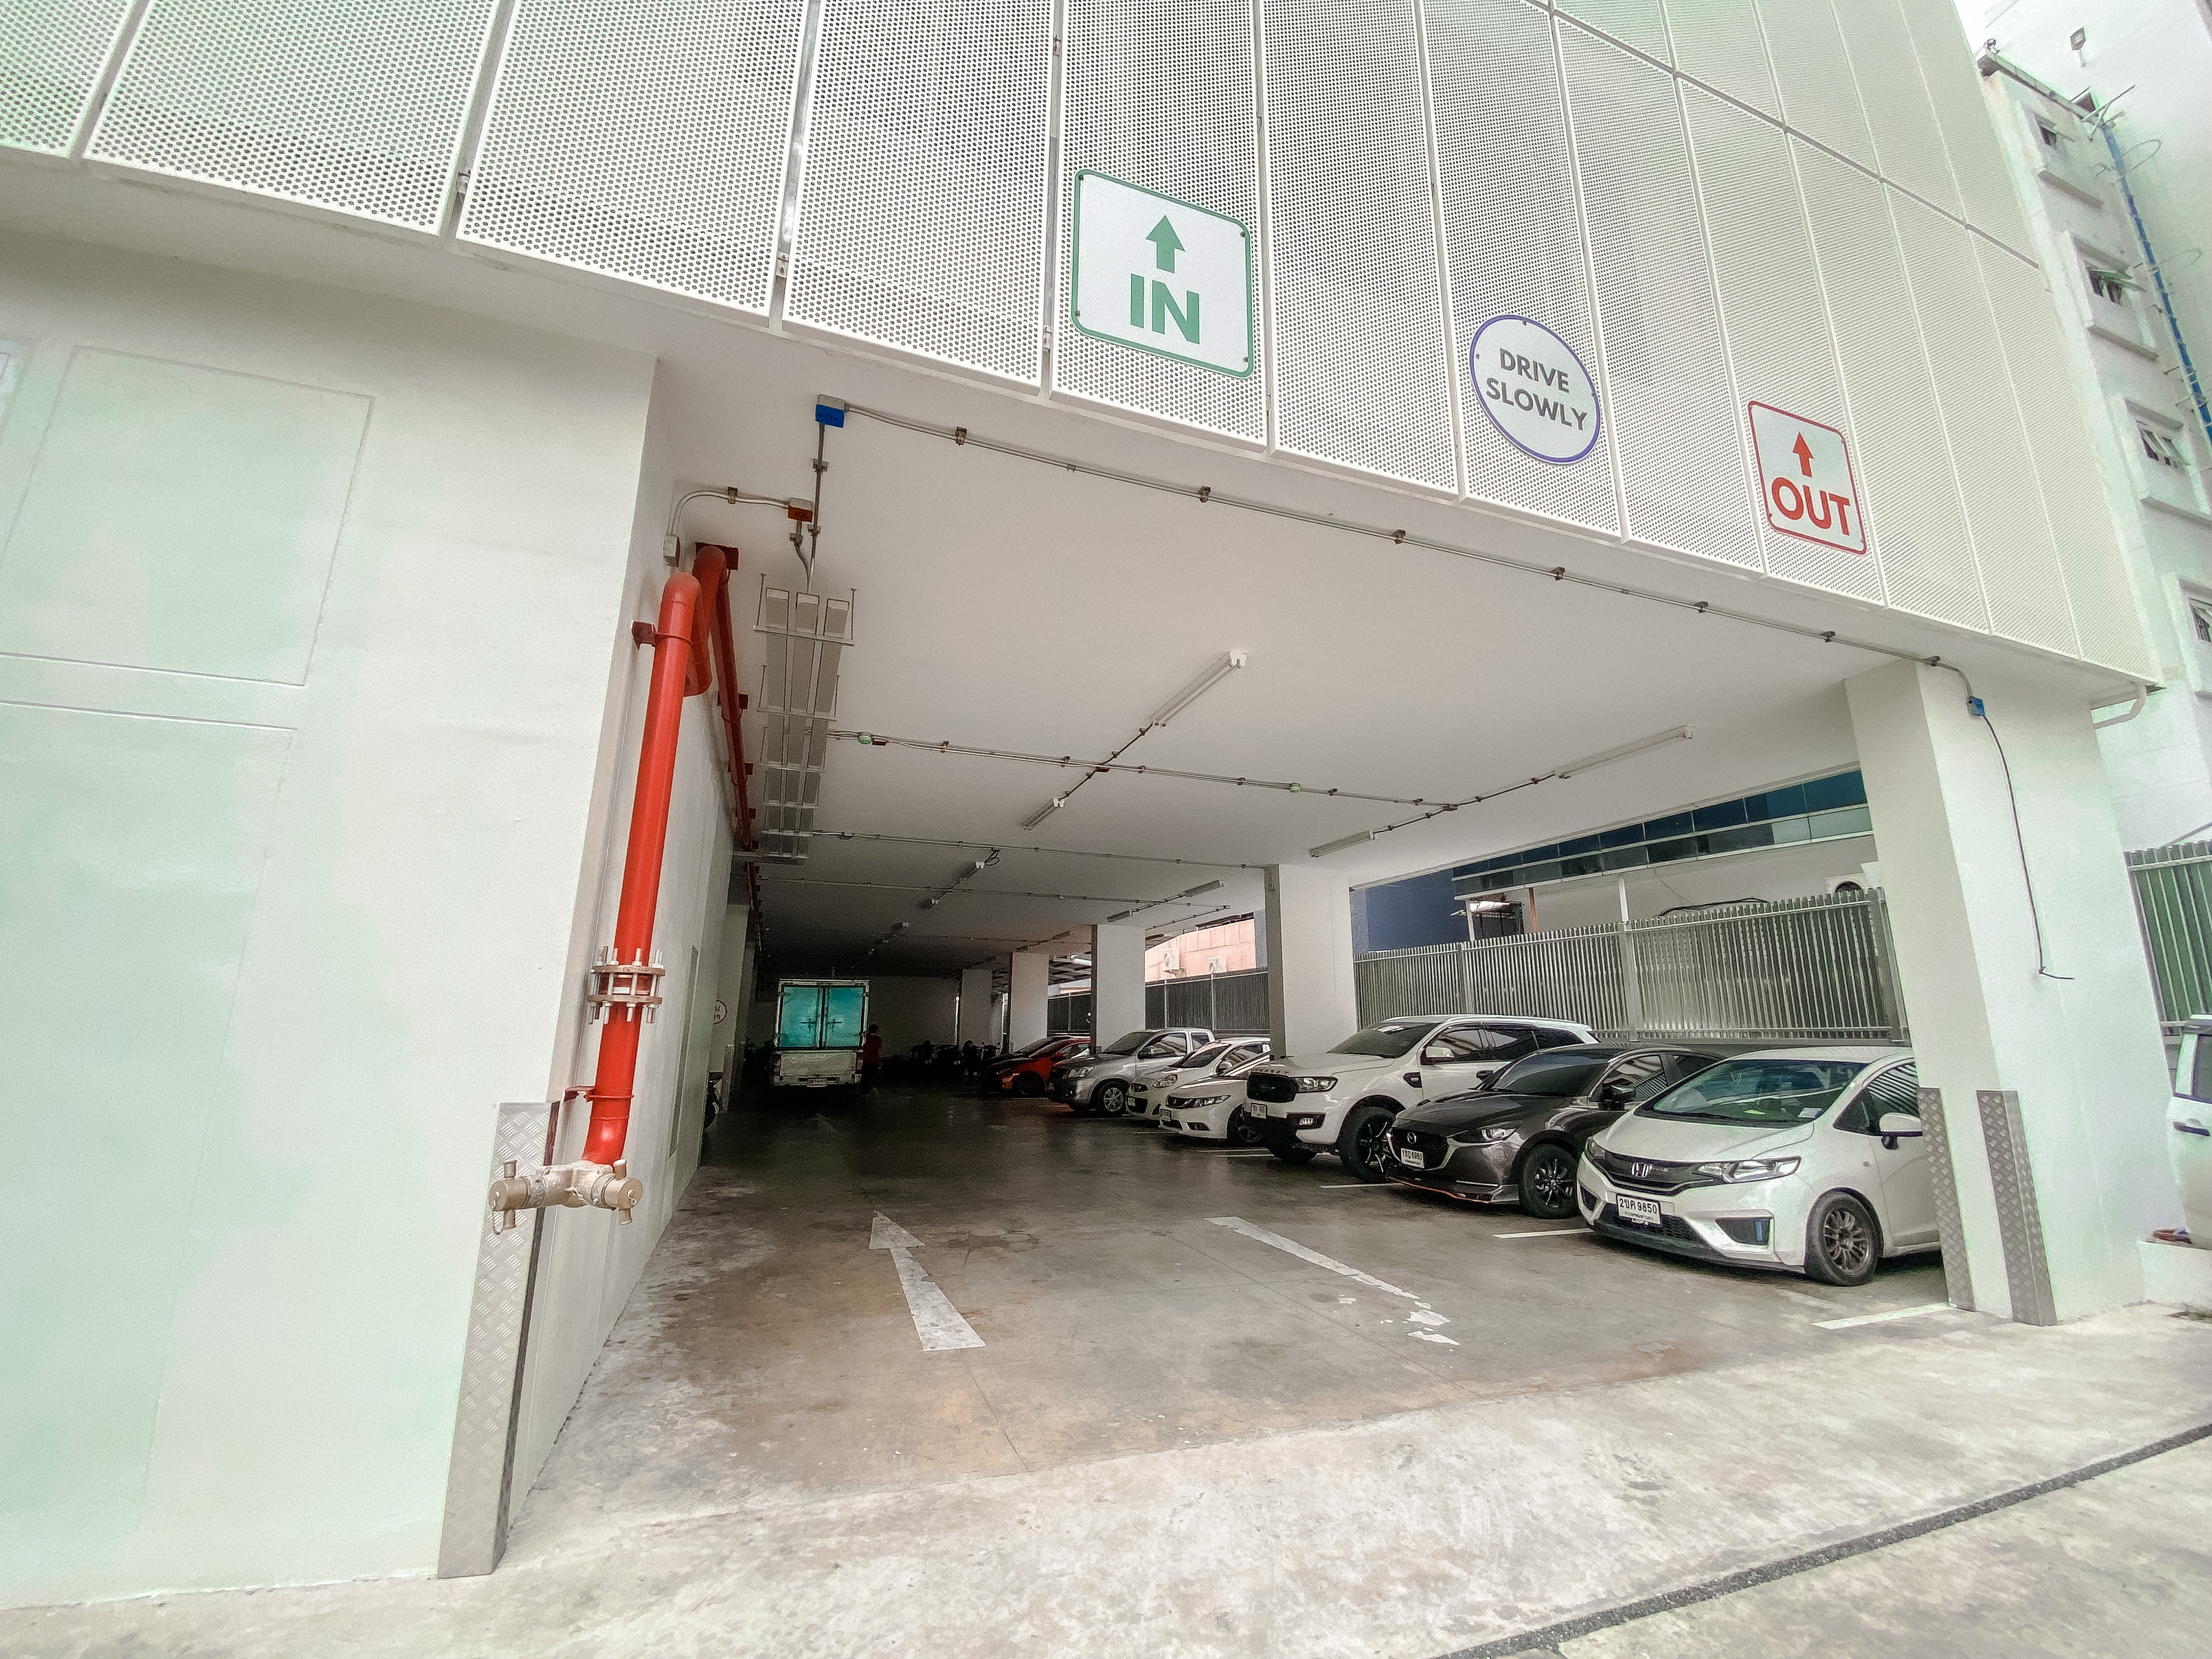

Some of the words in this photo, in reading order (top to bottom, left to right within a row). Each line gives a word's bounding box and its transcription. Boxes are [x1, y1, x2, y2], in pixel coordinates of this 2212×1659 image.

[1130, 273, 1200, 345] IN
[1499, 347, 1570, 394] DRIVE
[816, 411, 839, 421] CCTV
[1486, 377, 1588, 431] SLOWLY
[1771, 477, 1851, 537] OUT
[1637, 1201, 1657, 1214] 9850
